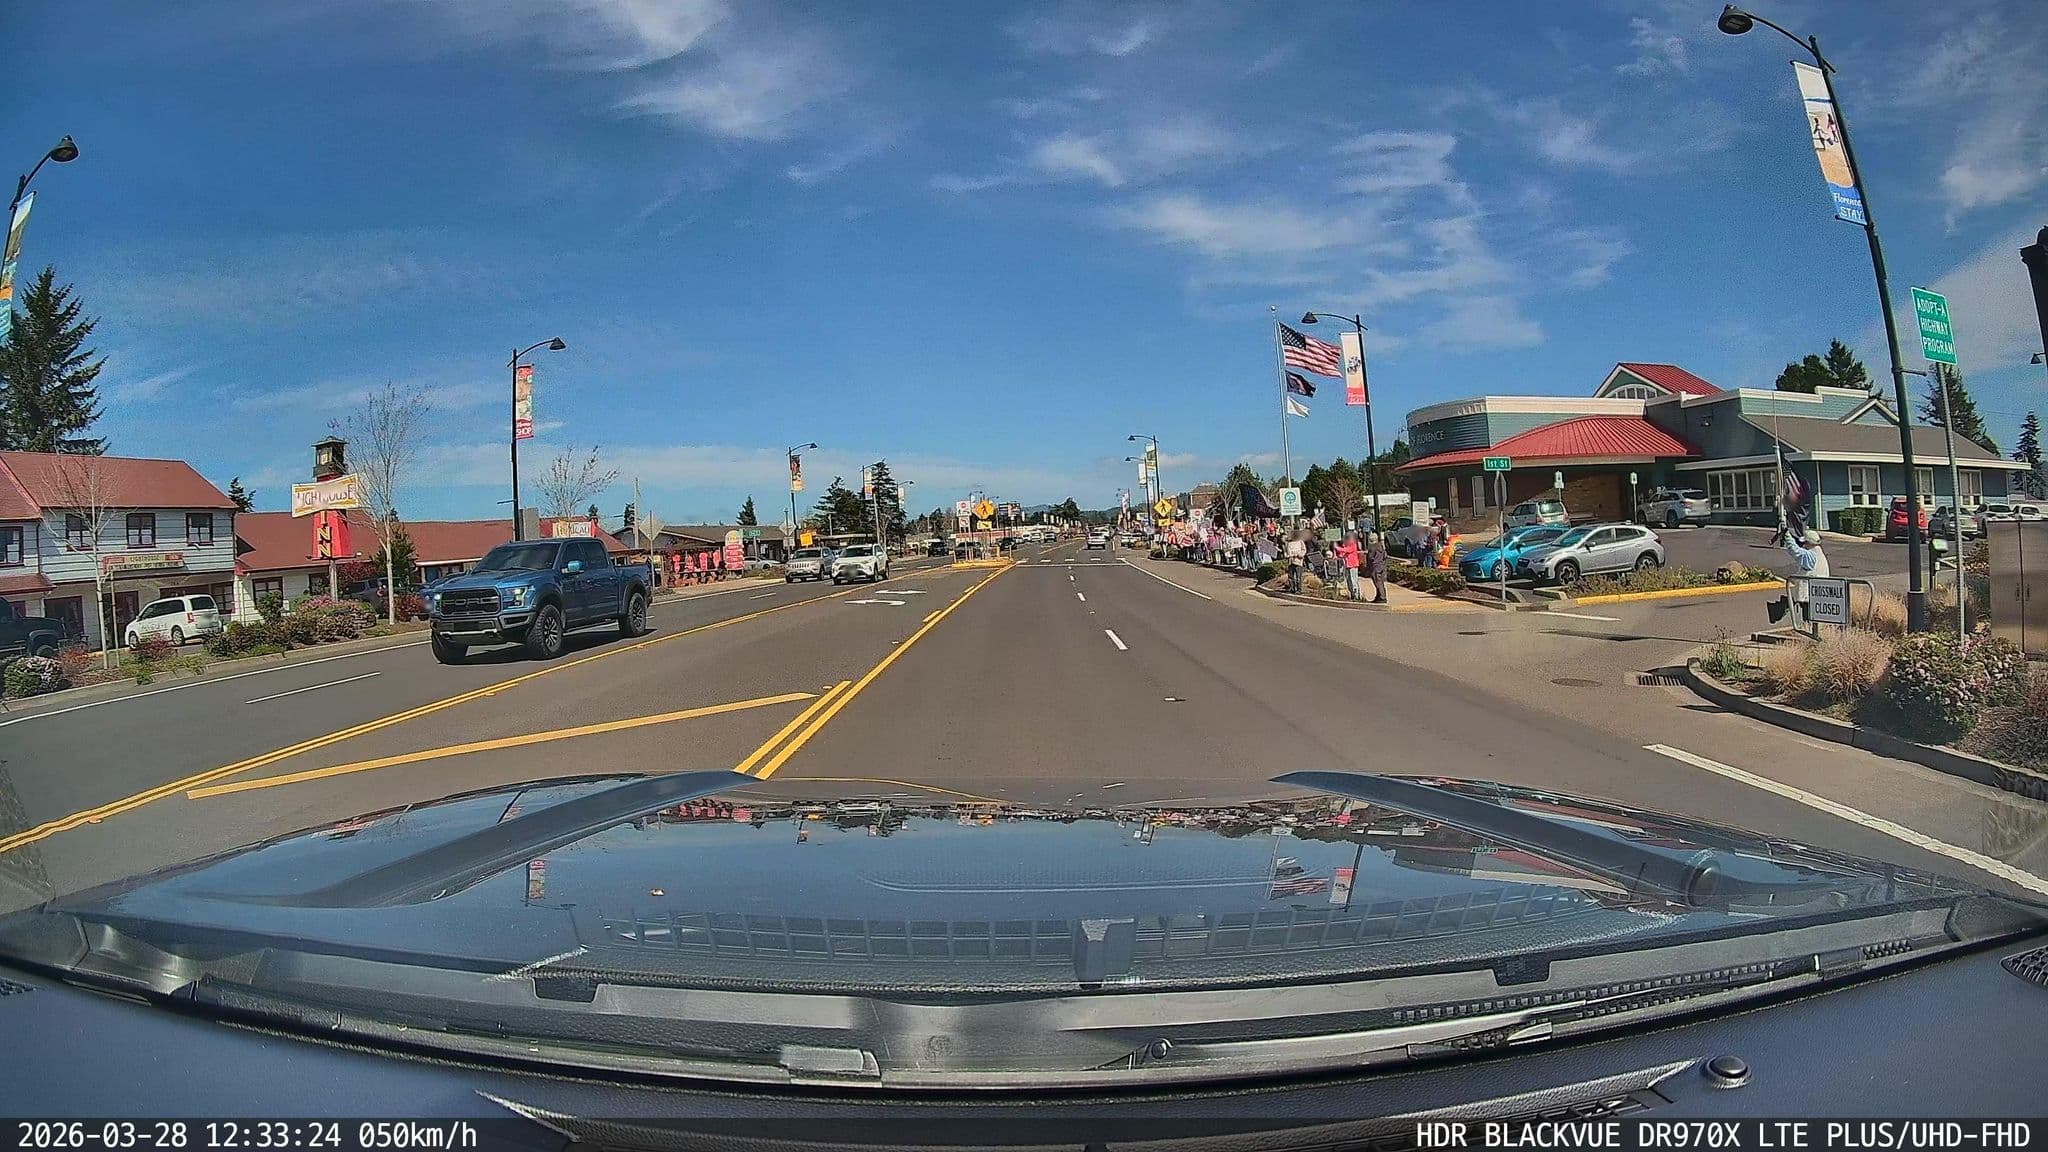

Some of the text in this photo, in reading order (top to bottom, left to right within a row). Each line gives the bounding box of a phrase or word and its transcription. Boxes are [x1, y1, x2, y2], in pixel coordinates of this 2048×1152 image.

[1840, 206, 1863, 220] STAY
[1917, 298, 1947, 317] ADOPT-A
[1920, 317, 1949, 336] HIGHWAY
[1923, 336, 1954, 355] PROGRAM
[1499, 460, 1508, 468] St
[317, 510, 332, 558] INN
[1811, 585, 1844, 598] CROSSWALK
[1815, 602, 1841, 616] CLOSED
